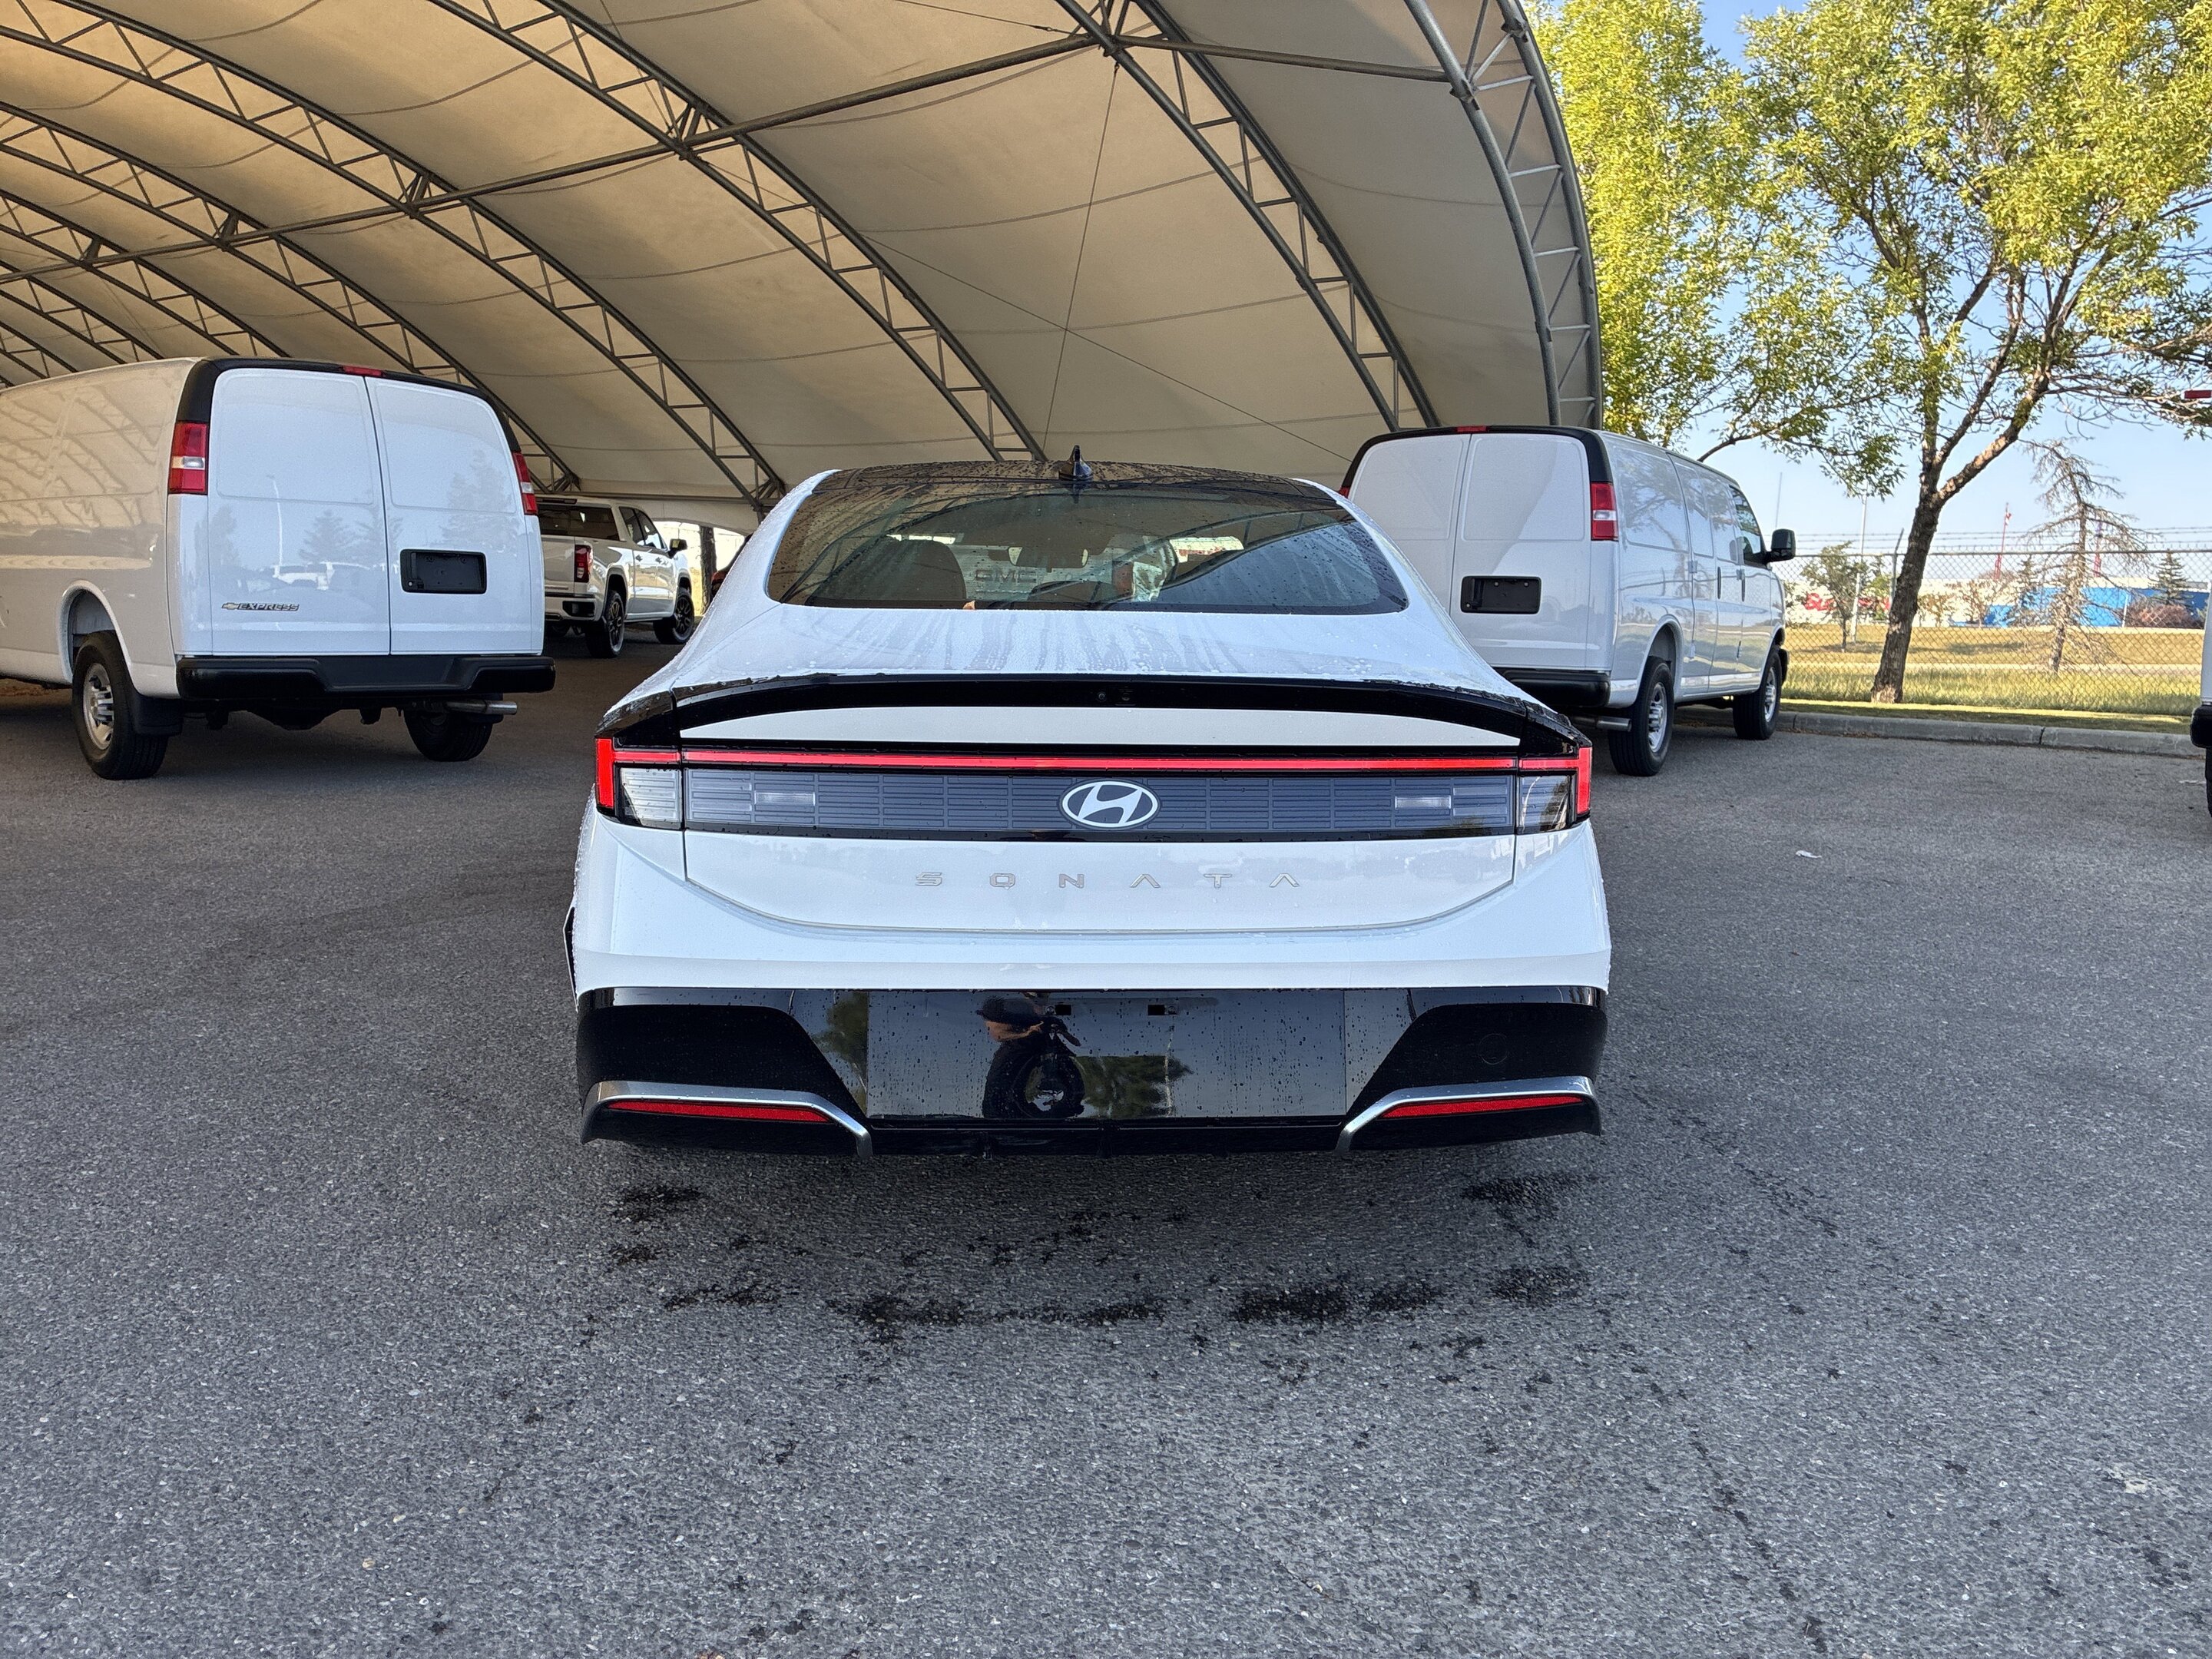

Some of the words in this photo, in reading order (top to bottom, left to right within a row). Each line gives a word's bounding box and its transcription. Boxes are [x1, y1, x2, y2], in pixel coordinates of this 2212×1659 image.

[975, 569, 1037, 583] GMC
[237, 603, 300, 611] EXPRESS
[915, 872, 1300, 889] SONATA
